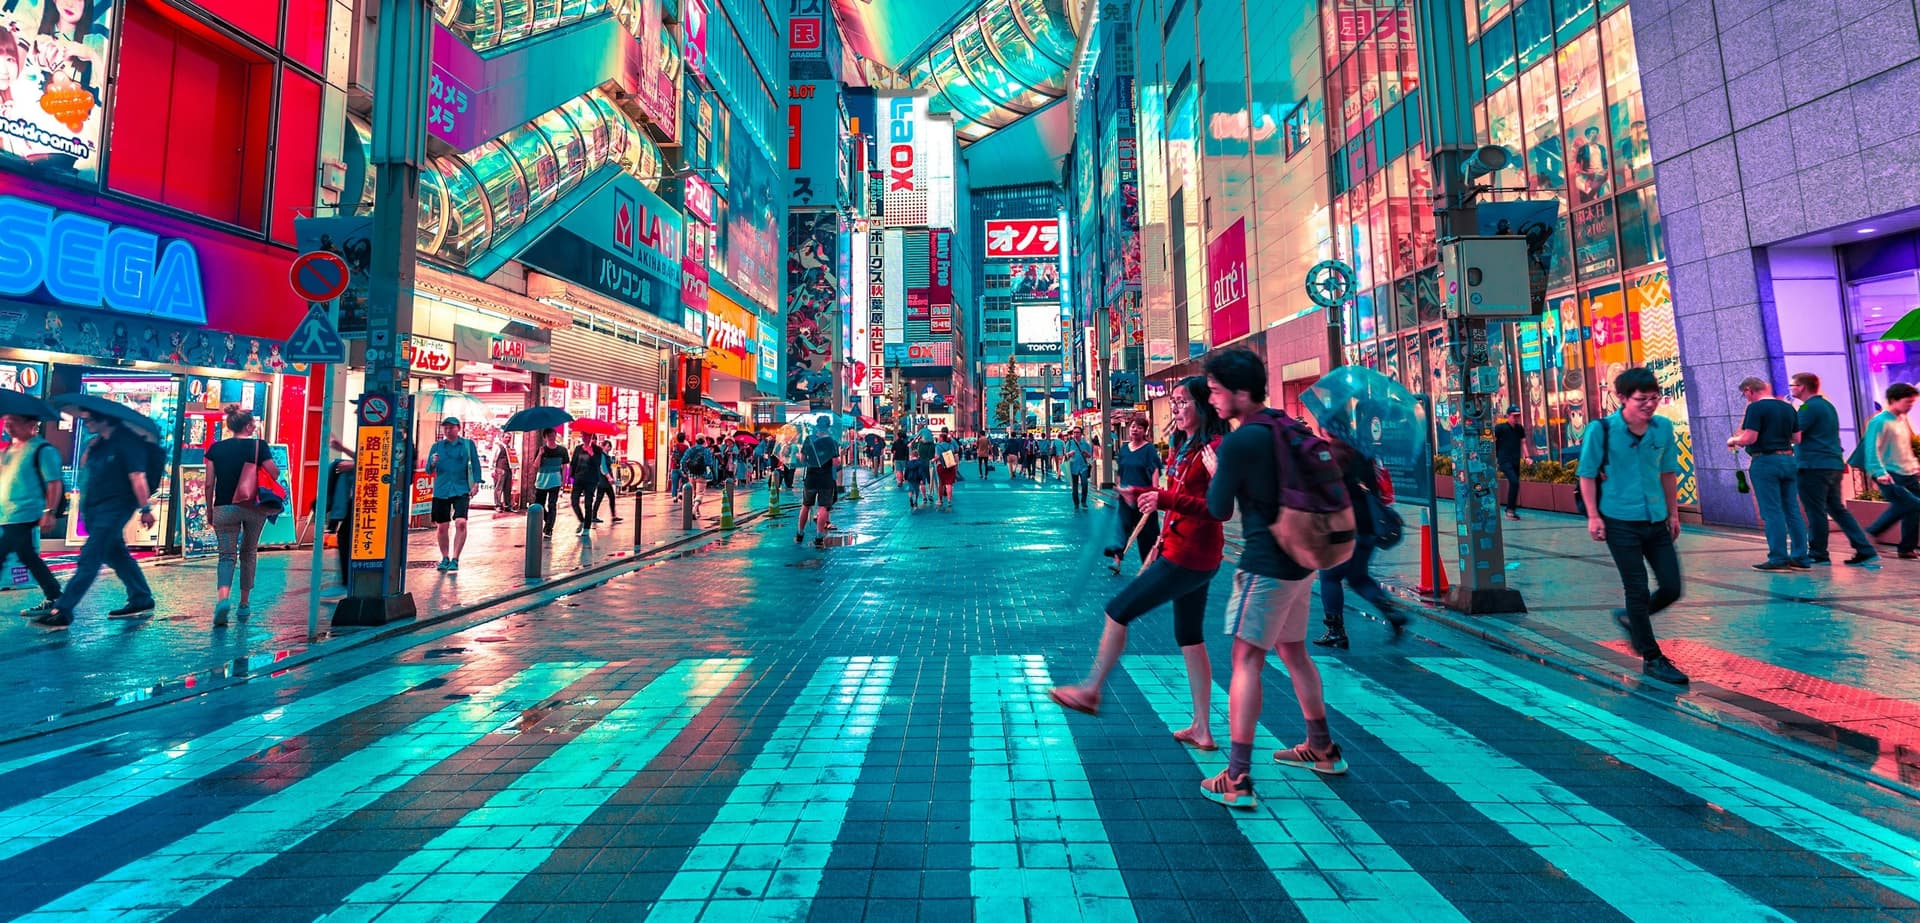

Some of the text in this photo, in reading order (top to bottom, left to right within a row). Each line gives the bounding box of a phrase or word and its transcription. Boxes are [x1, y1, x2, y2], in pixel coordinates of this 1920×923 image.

[431, 73, 468, 113] カメラ
[639, 204, 681, 265] LABI
[0, 195, 207, 325] SEGA
[638, 248, 680, 284] AKIHABARA
[503, 340, 526, 358] LABI
[1027, 344, 1057, 352] TOKYO
[361, 436, 381, 555] 路上喫煙禁止です。
[417, 478, 434, 490] au
